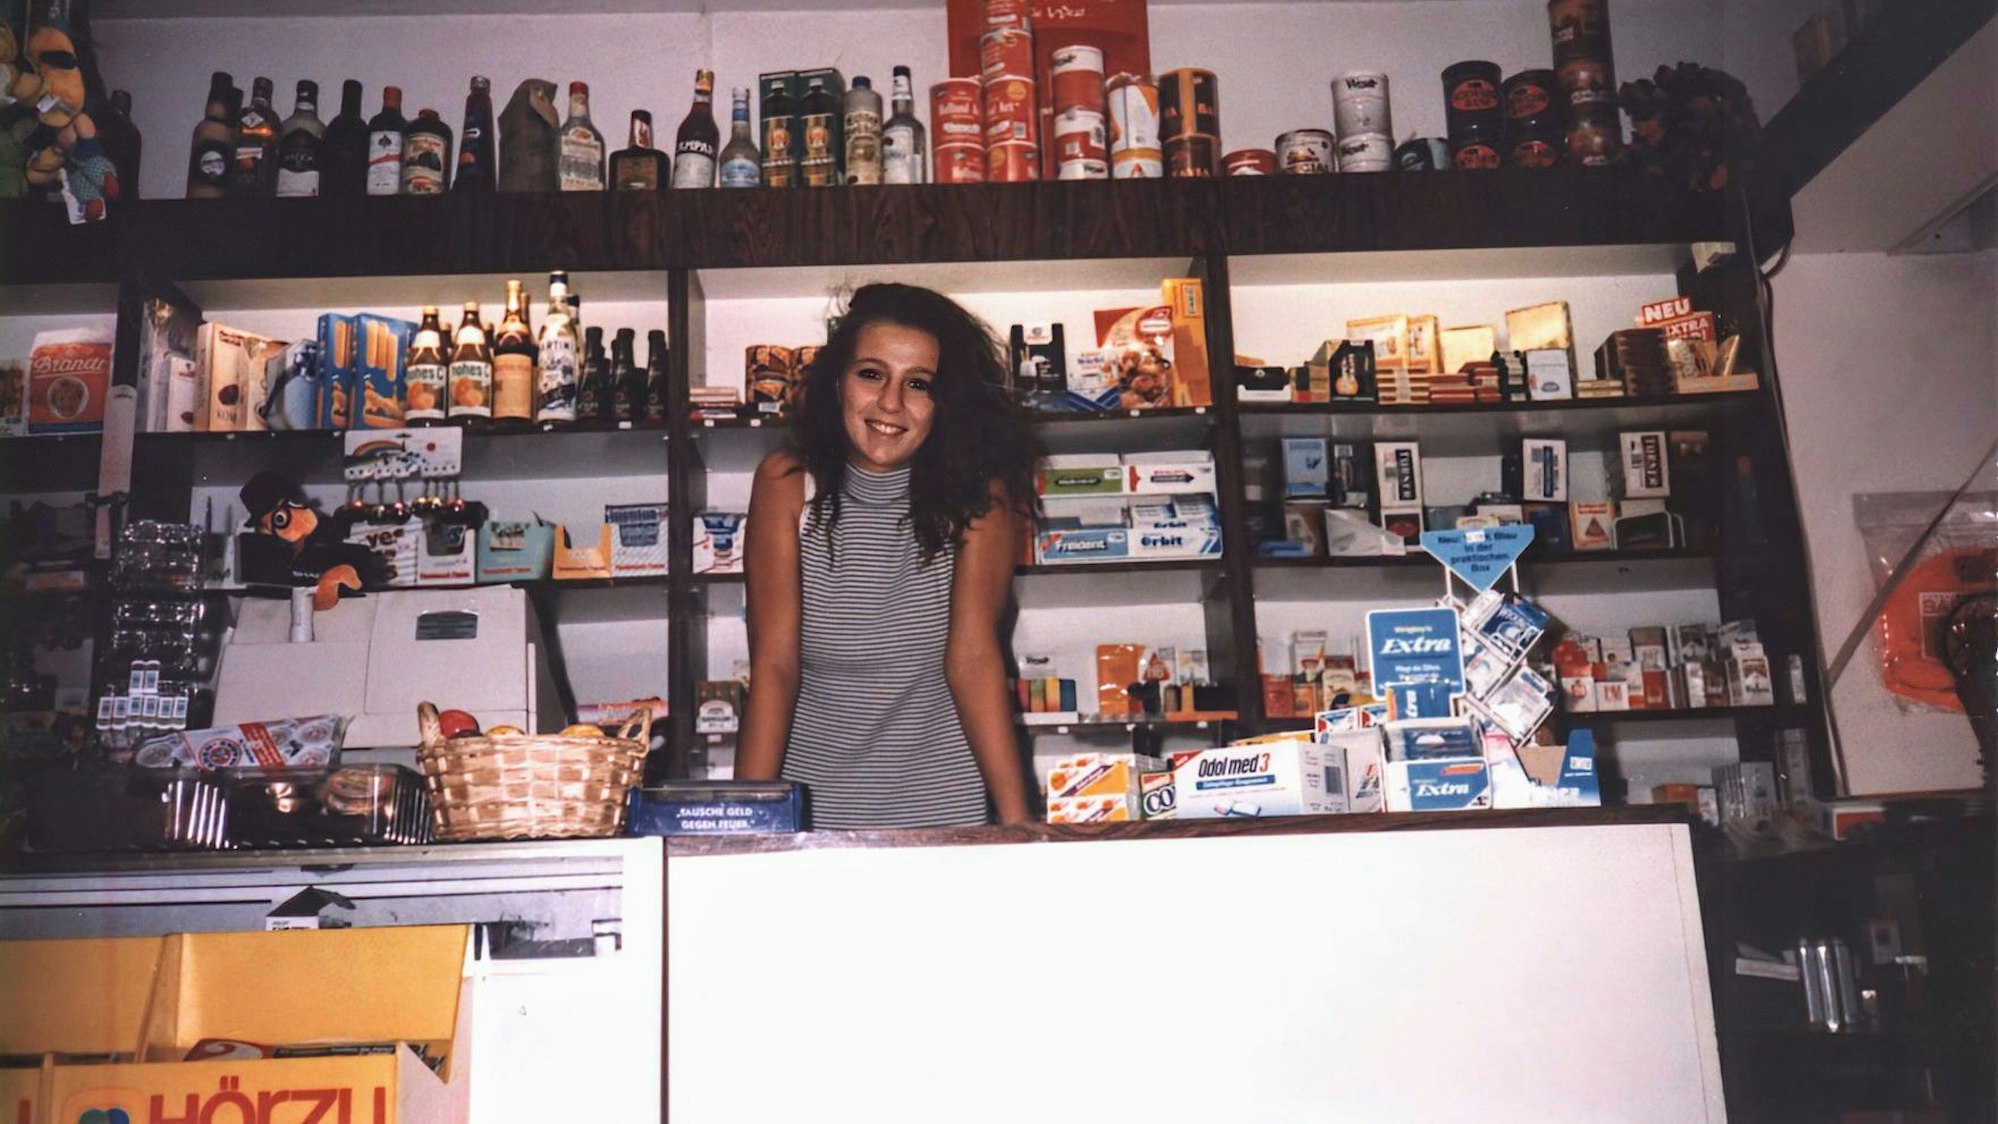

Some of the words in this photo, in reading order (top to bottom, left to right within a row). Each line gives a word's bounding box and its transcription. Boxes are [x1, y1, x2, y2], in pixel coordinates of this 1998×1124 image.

[1644, 298, 1690, 323] NEU
[33, 355, 105, 374] Brandt
[1141, 534, 1183, 547] Orbit
[1380, 635, 1453, 655] Extra
[1198, 755, 1226, 778] Odol
[1227, 754, 1259, 775] med
[1259, 752, 1271, 773] 3
[1416, 782, 1470, 797] Extra
[1145, 788, 1176, 813] CO
[726, 807, 753, 817] GELD
[681, 820, 717, 830] GEGEN
